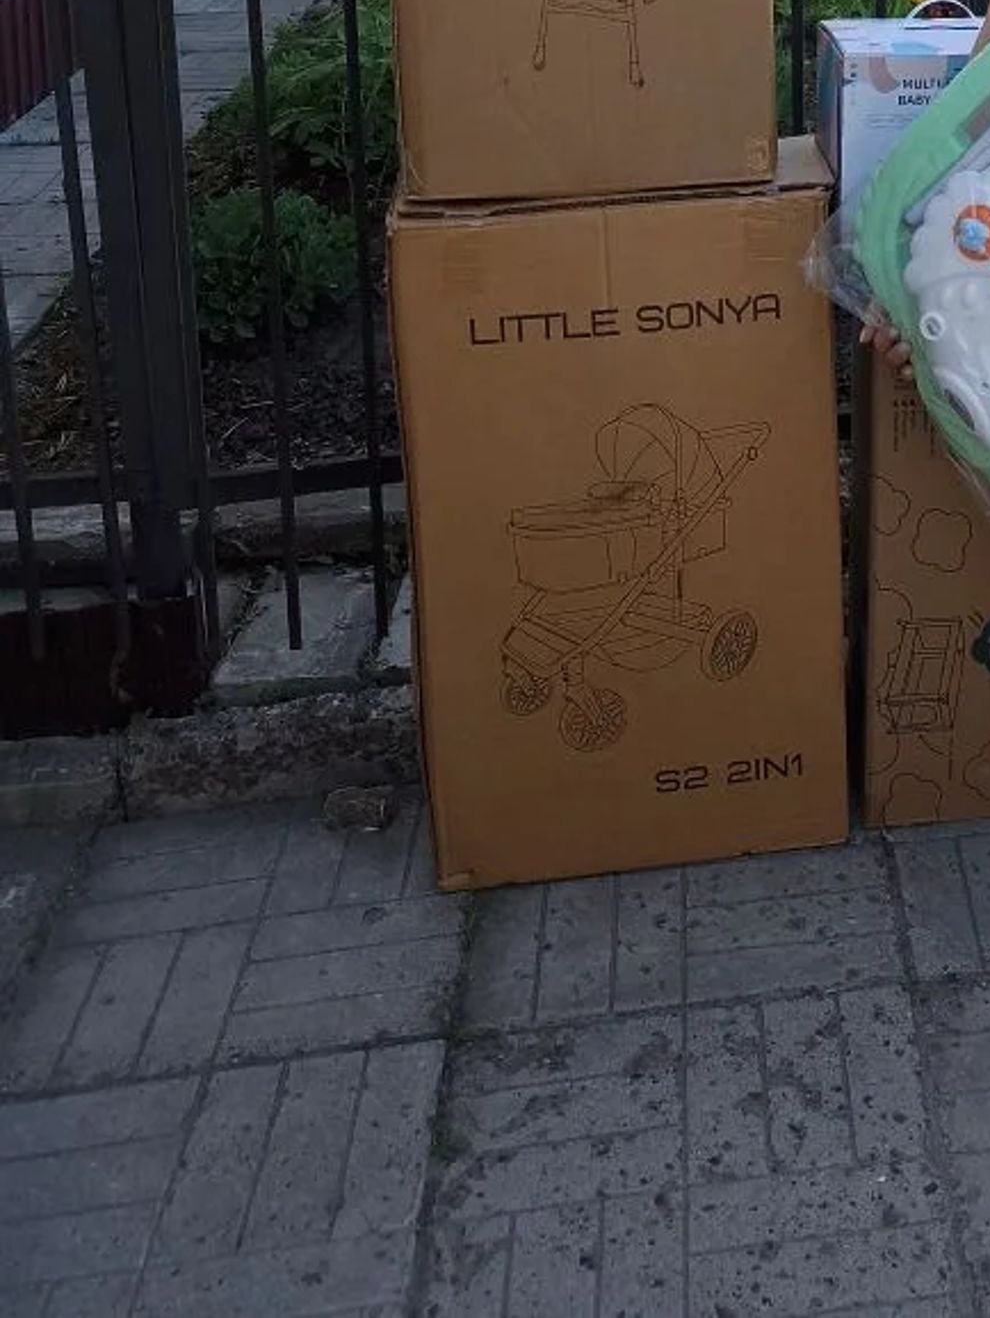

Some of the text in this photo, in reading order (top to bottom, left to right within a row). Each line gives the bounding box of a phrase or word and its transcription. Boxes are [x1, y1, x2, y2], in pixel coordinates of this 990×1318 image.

[898, 94, 931, 106] BABY
[469, 292, 782, 345] LITTLE SONYA
[655, 752, 804, 793] S2 2IN1
